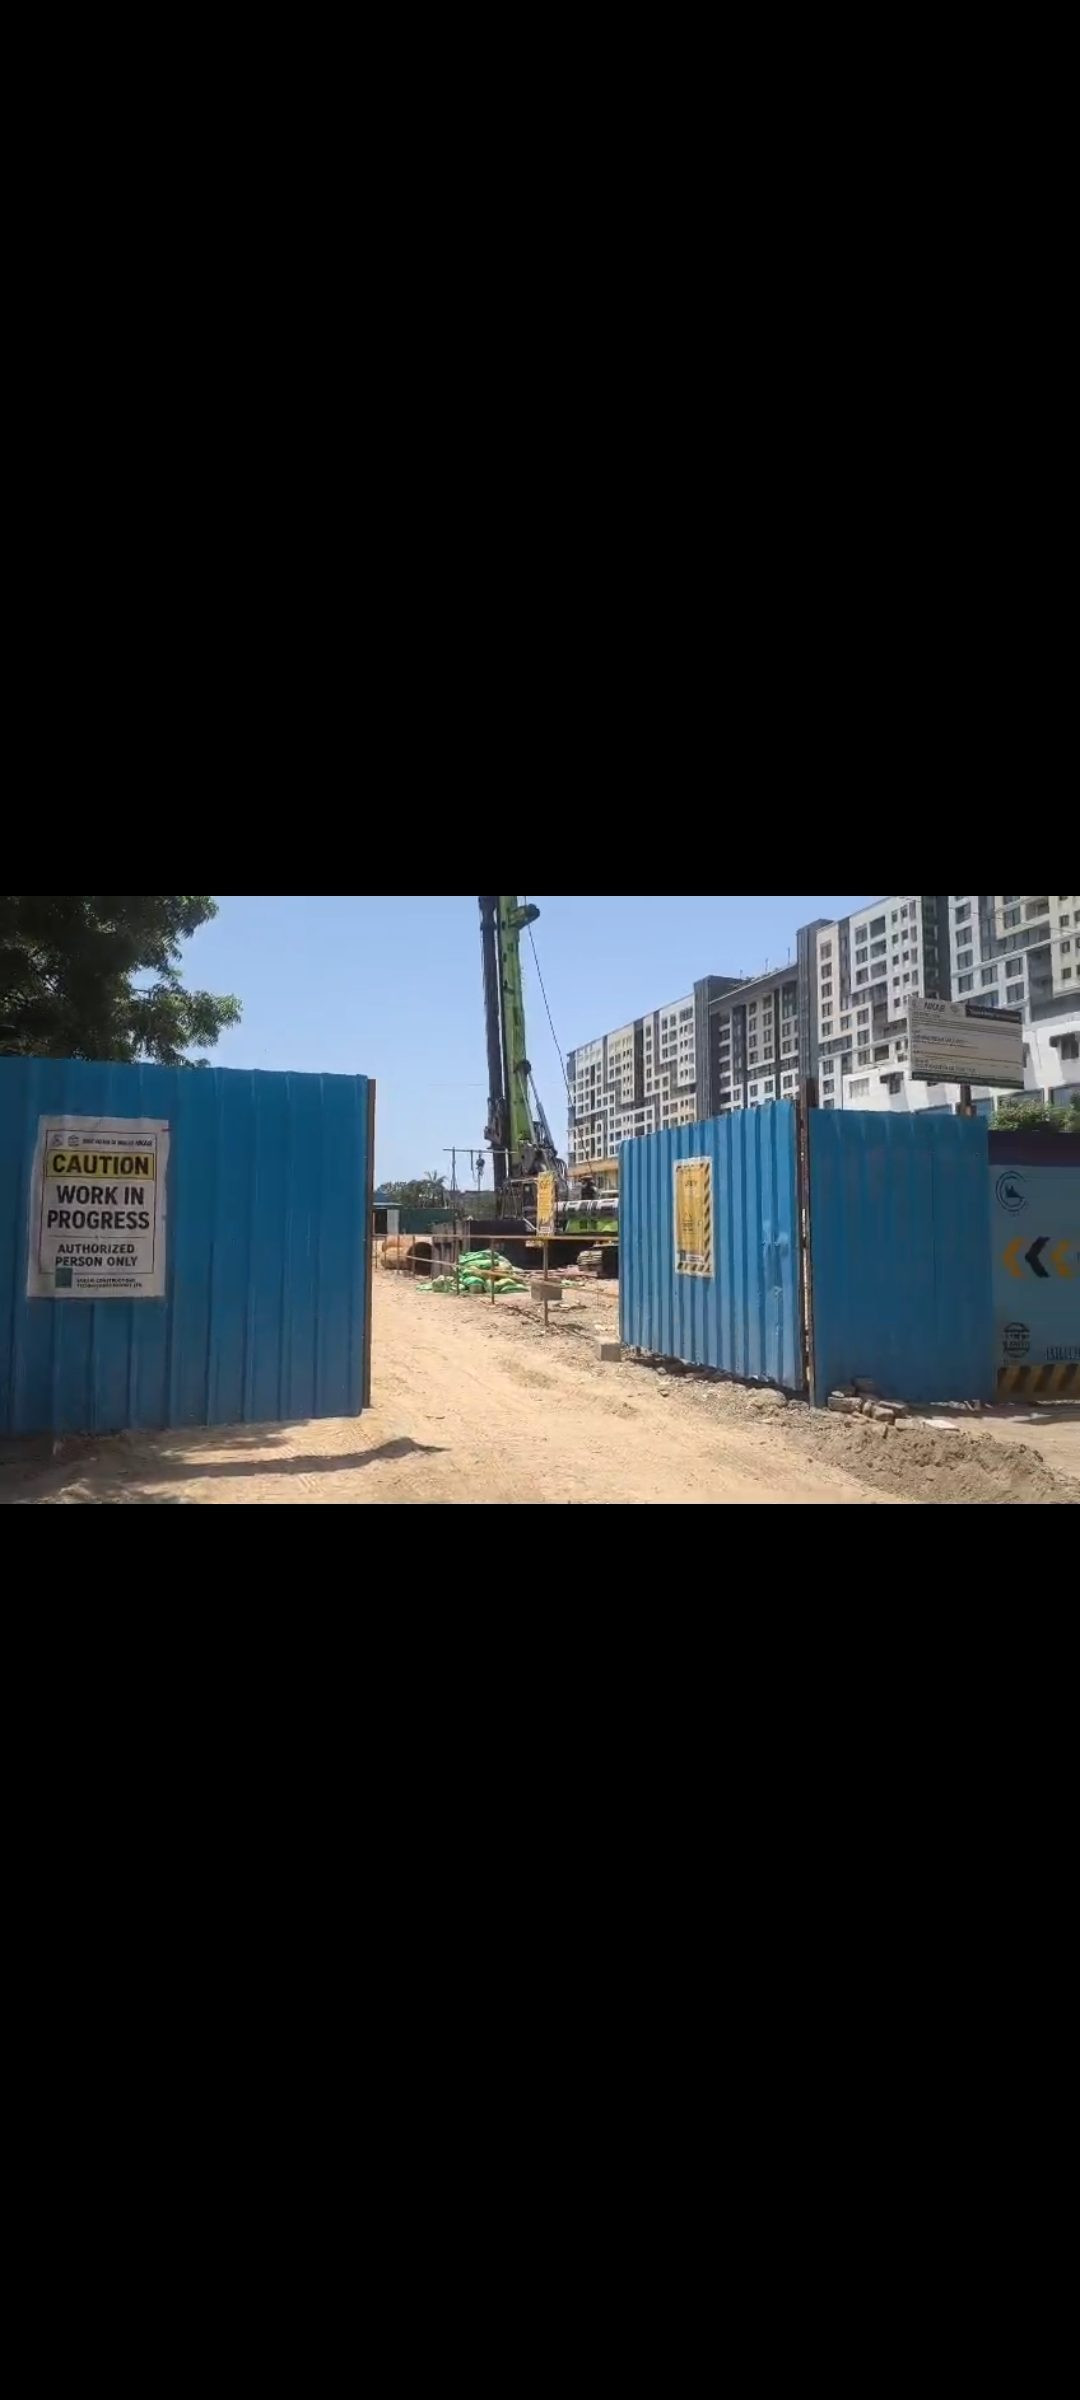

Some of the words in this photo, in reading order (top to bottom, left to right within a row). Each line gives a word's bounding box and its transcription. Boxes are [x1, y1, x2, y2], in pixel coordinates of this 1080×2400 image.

[53, 1154, 149, 1175] CAUTION
[56, 1185, 118, 1205] WORK
[124, 1187, 144, 1206] IN
[47, 1210, 150, 1230] PROGRESS
[58, 1243, 135, 1254] AUTHORIZED
[55, 1256, 103, 1267] PERSON
[107, 1256, 138, 1267] ONLY
